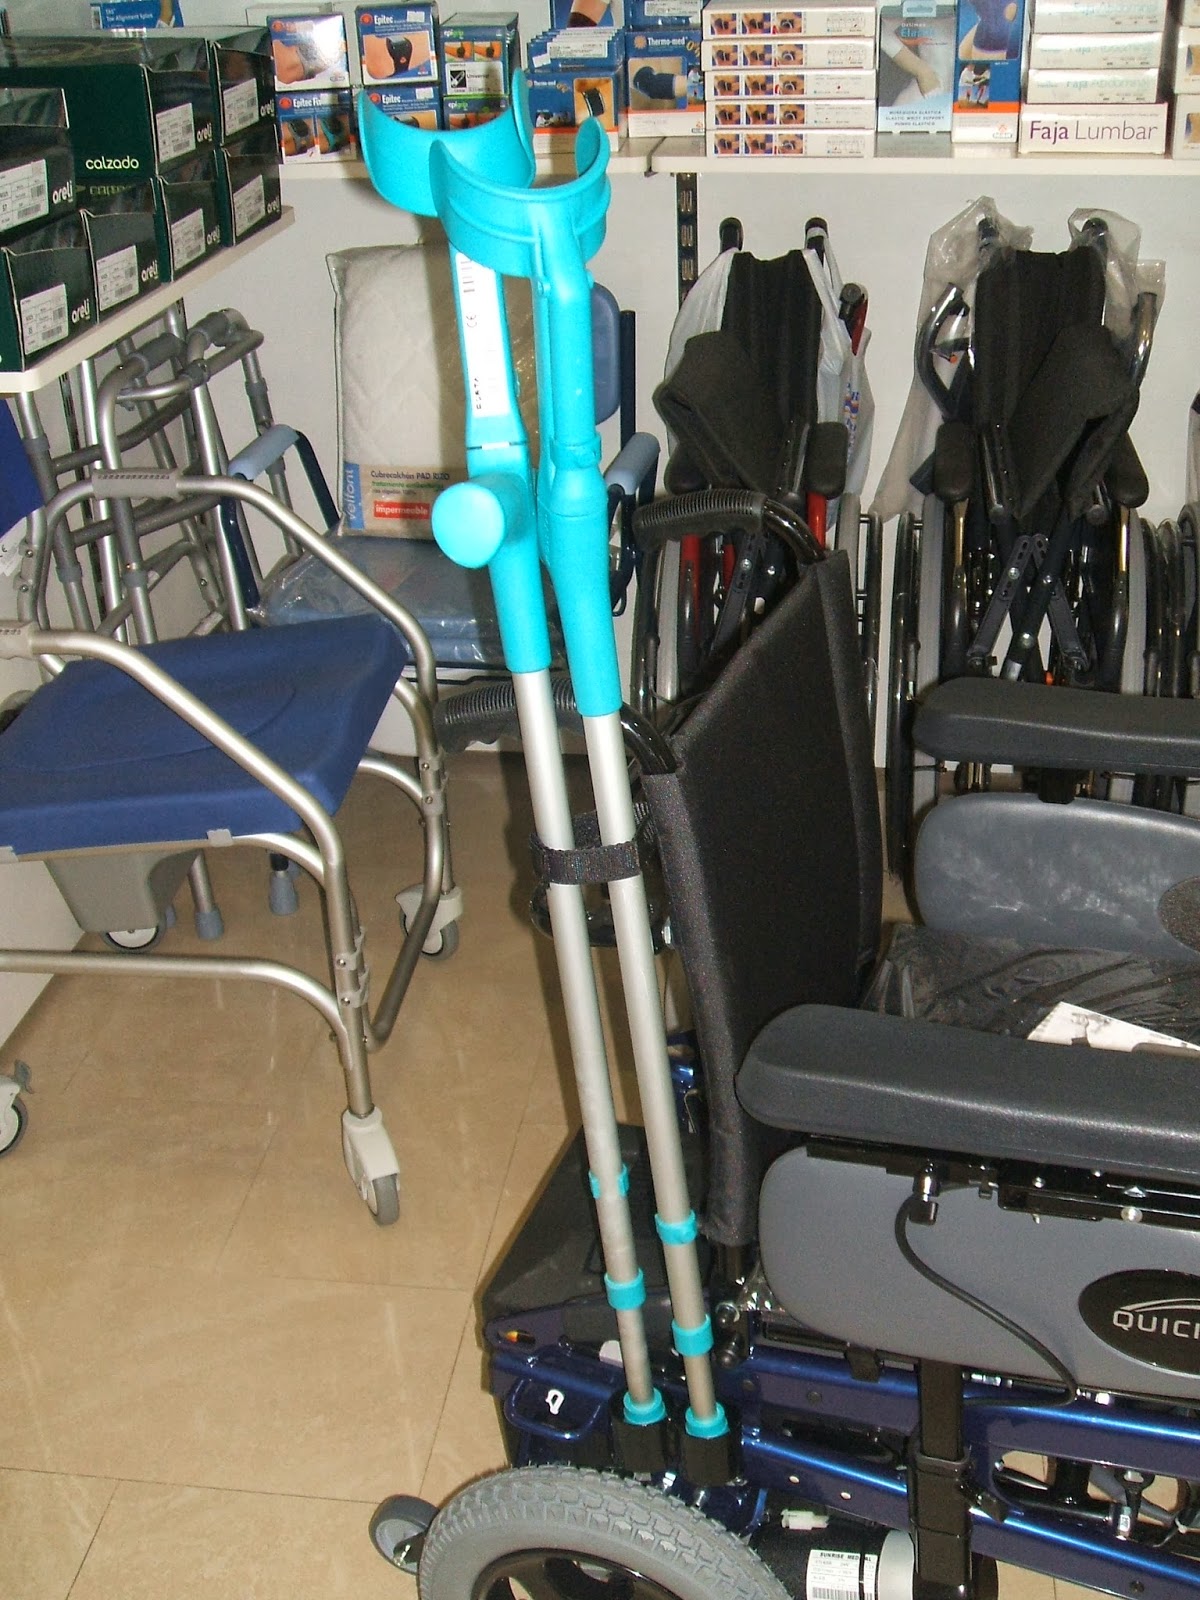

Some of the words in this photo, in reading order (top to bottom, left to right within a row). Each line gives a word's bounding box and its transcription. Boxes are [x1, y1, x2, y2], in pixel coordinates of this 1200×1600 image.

[373, 14, 394, 26] Epitec
[293, 97, 312, 109] Epitec
[381, 94, 401, 105] Epitec
[1029, 120, 1069, 145] Faja
[1075, 120, 1158, 140] Lumbar
[85, 155, 140, 170] calzado
[416, 472, 431, 480] PAD
[375, 503, 429, 516] impermeable
